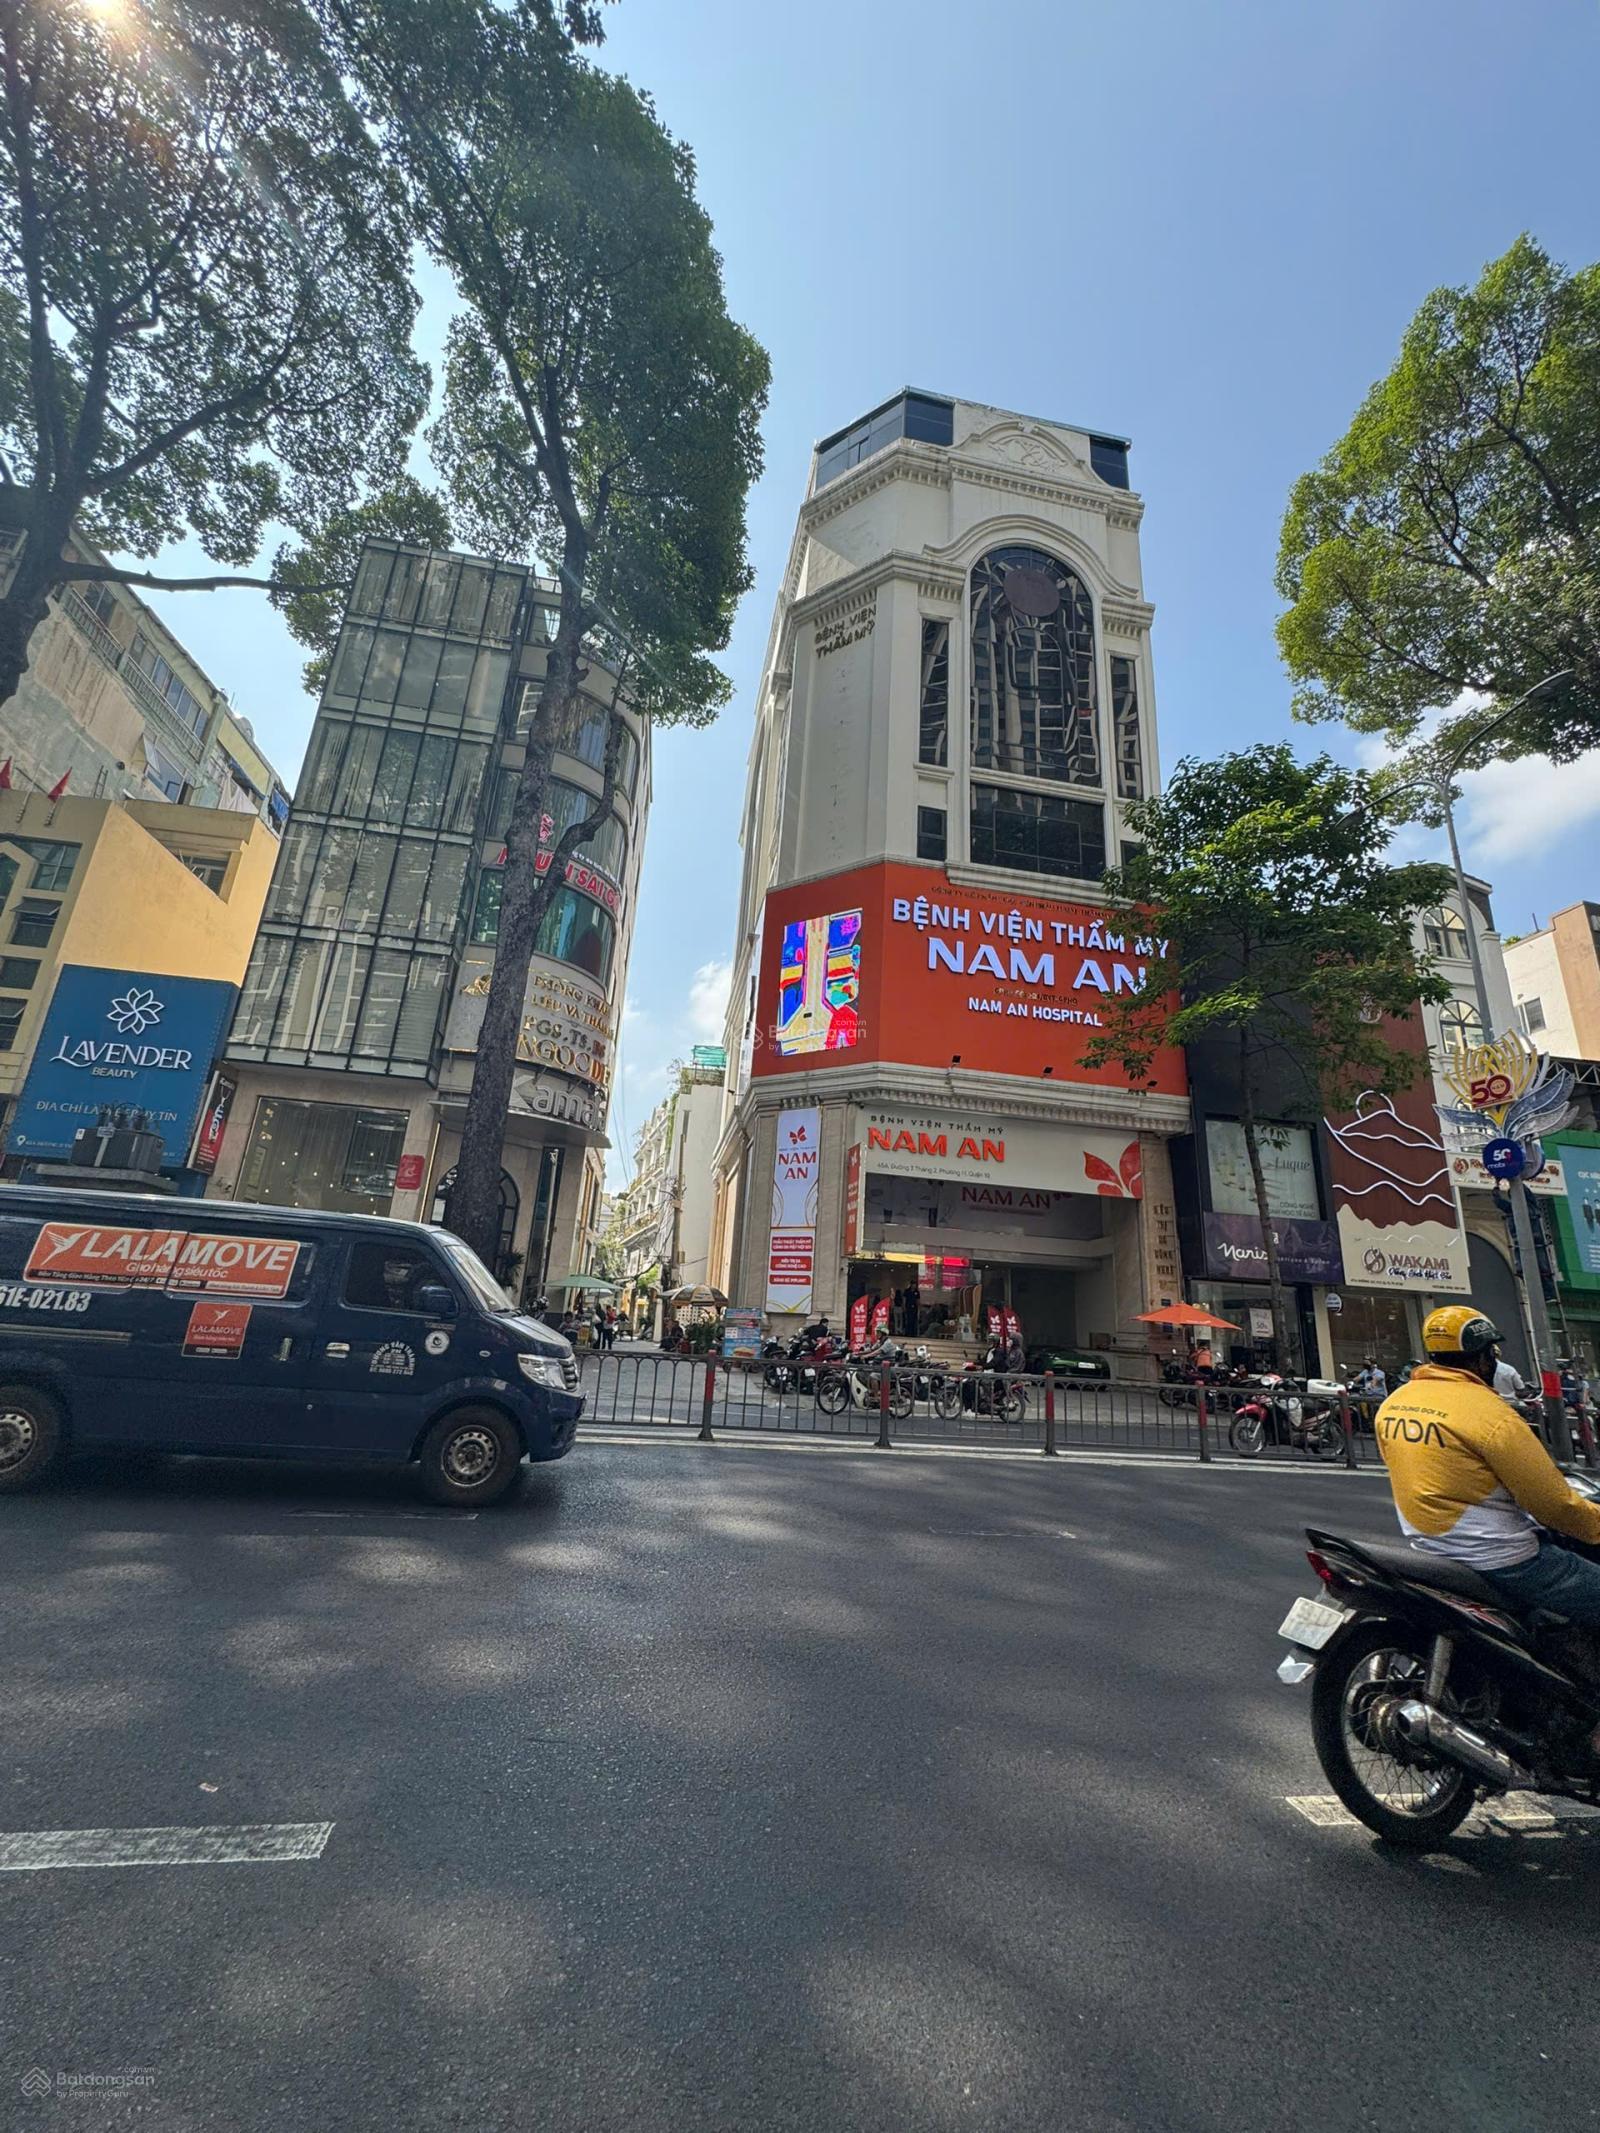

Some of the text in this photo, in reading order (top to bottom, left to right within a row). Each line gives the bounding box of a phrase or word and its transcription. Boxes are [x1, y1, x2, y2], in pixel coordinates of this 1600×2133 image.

[893, 895, 970, 931] BỆNH
[979, 908, 1043, 944] VIỆN
[1050, 919, 1125, 953] THẨM
[928, 936, 1148, 996] NAM AN
[968, 997, 1103, 1027] NAM AN HOSPITAL
[49, 1035, 193, 1071] LAVENDER
[92, 1066, 139, 1079] BEAUTY
[1471, 1073, 1512, 1104] 50
[36, 1100, 57, 1113] ĐỊA
[59, 1101, 83, 1114] CHỈ
[158, 1106, 178, 1122] TÍN
[870, 1114, 904, 1125] BỆNH
[911, 1118, 942, 1129] VIỆN
[867, 1126, 1006, 1163] NAM AN
[778, 1151, 817, 1166] NAM
[784, 1167, 809, 1180] AN
[962, 1186, 1051, 1209] NAM AN
[80, 1231, 295, 1272] LALAMOVE
[1387, 1253, 1450, 1271] WAKAMI
[208, 1266, 229, 1279] tốc
[191, 1325, 243, 1335] LALAMOVE
[1383, 1416, 1446, 1449] TADA
